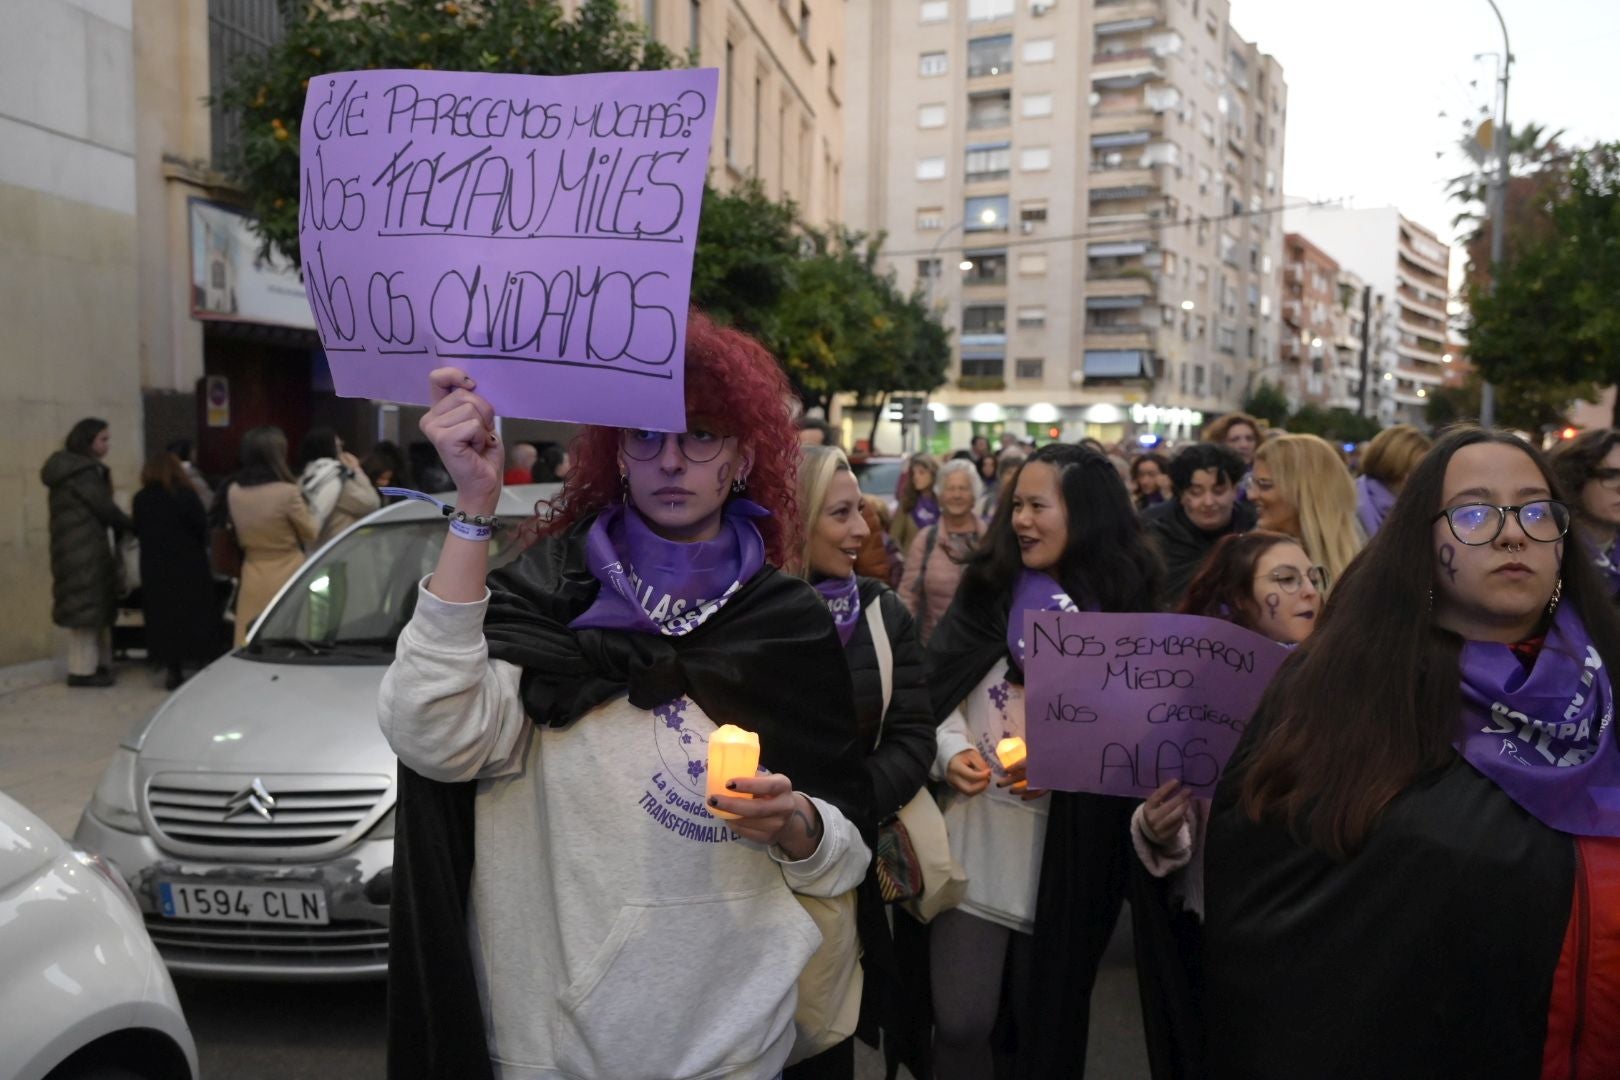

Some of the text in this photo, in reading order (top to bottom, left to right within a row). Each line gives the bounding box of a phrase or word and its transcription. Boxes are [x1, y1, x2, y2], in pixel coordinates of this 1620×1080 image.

[384, 84, 561, 139] PARECEMOS
[567, 90, 706, 140] MUCHAS?
[372, 140, 536, 235] FALTAN
[368, 271, 414, 345] OS
[1115, 635, 1255, 674] SEMBRARON
[652, 772, 667, 791] La
[1100, 738, 1219, 789] ALAS
[638, 790, 728, 843] TRANSFÓRMALA
[178, 888, 320, 920] 1594 CLN
